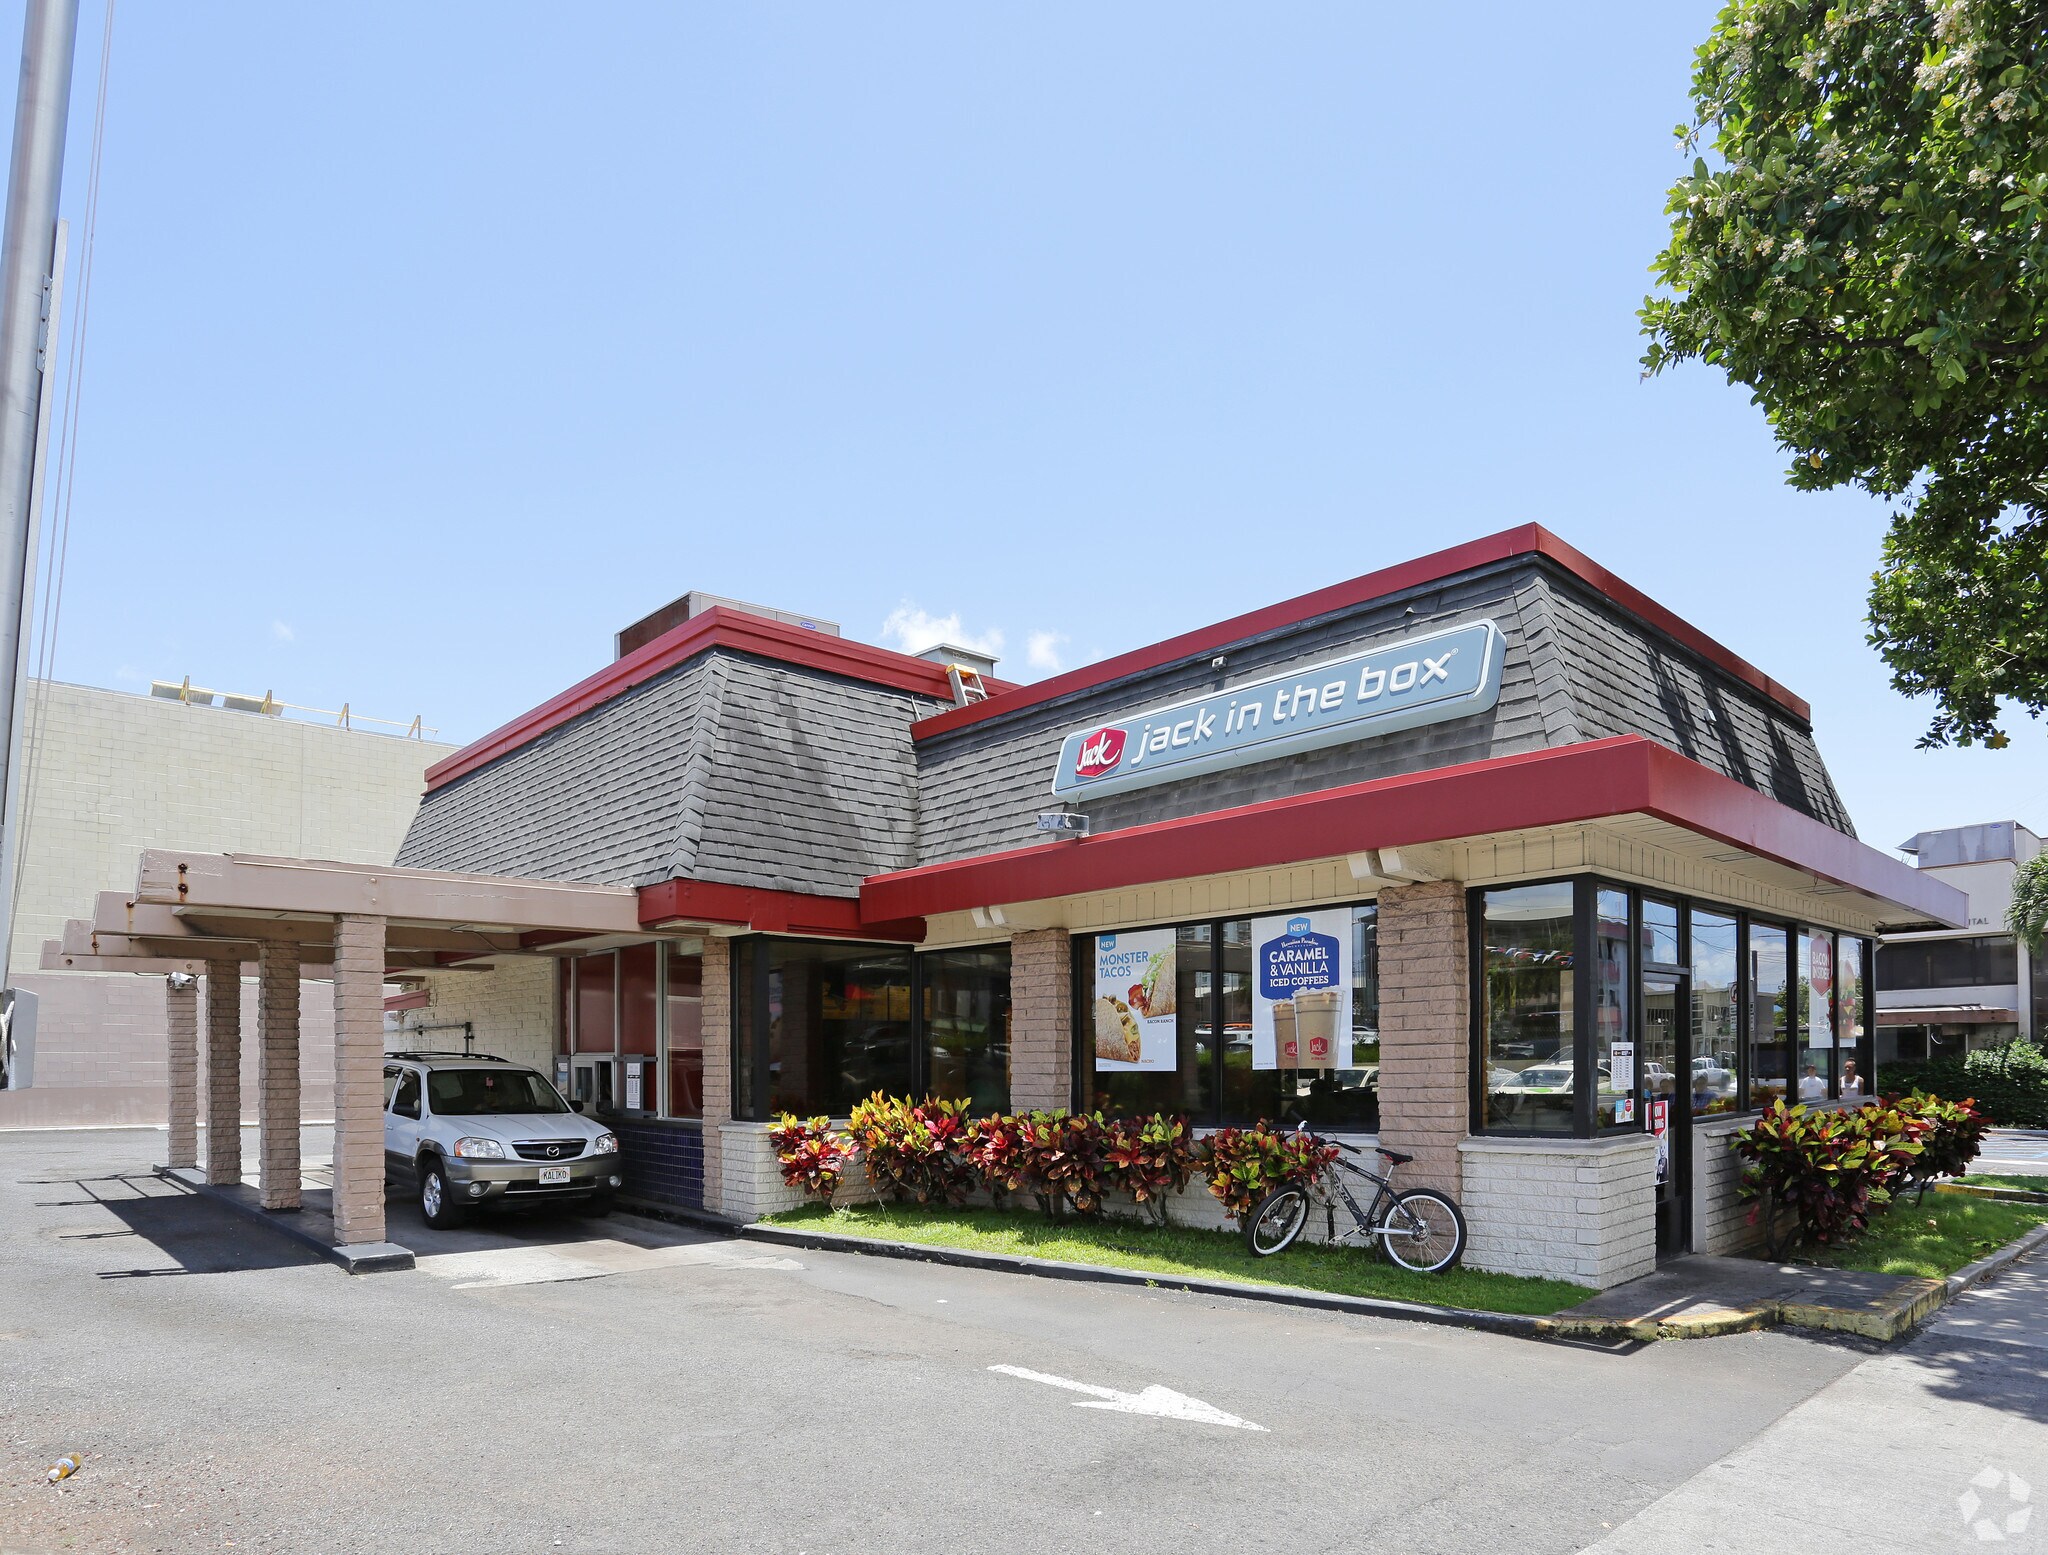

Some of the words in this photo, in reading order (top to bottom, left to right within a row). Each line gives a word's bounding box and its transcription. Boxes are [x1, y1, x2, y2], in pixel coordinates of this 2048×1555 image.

[1131, 708, 1217, 765] jack
[1225, 700, 1262, 733] in
[1272, 680, 1347, 722] the
[1076, 732, 1121, 772] Jack
[1290, 923, 1308, 932] NEW
[1100, 941, 1115, 949] NEW
[1100, 951, 1149, 966] MONSTER
[1269, 947, 1329, 963] CARAMEL
[1812, 951, 1830, 966] BACON
[1099, 965, 1131, 979] TACOS
[1270, 964, 1278, 977] &
[1279, 961, 1329, 976] VANILLA
[1270, 978, 1290, 987] ICED
[1291, 975, 1329, 986] COFFEES
